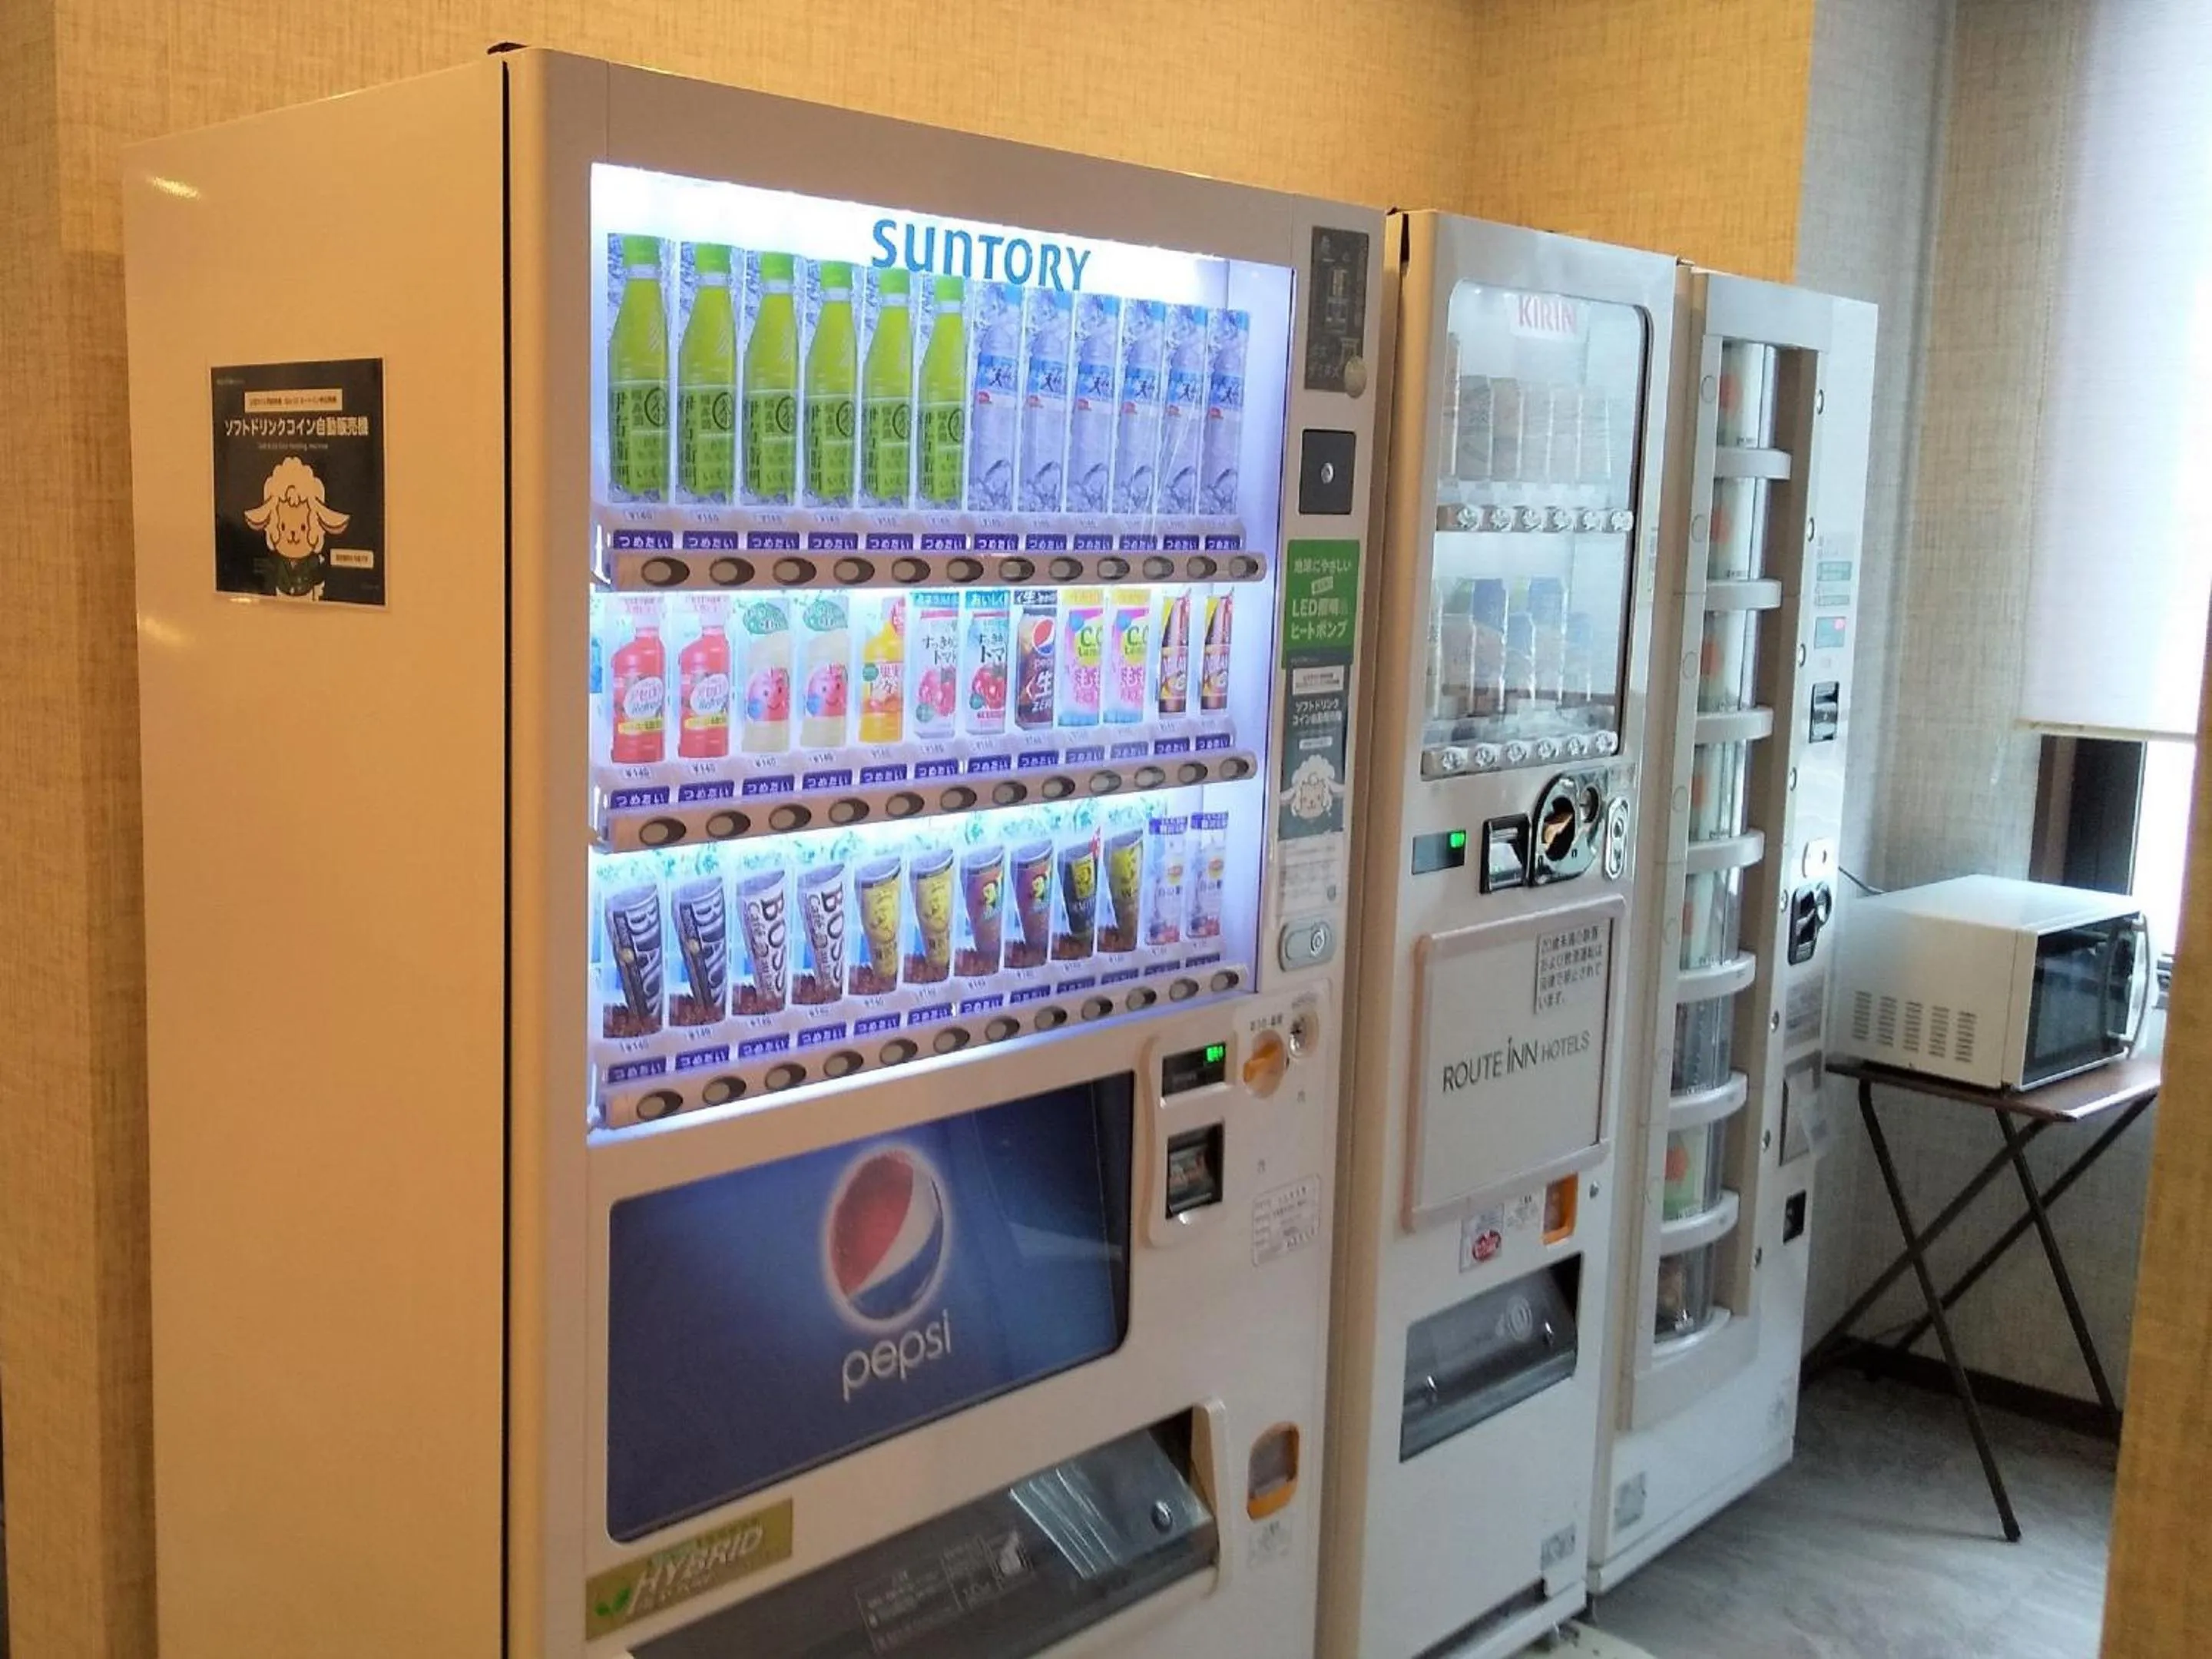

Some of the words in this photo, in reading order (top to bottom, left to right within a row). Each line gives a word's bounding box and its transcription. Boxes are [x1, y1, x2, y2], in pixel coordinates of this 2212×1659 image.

[871, 219, 1091, 292] SUNTORY
[1517, 294, 1575, 333] KIRIN
[1290, 619, 1348, 640] ヒートポンプ
[1442, 1050, 1503, 1093] ROUTE
[1541, 1029, 1591, 1063] HOTELS
[842, 1308, 952, 1403] pepsi
[628, 1521, 764, 1614] HYBRID
